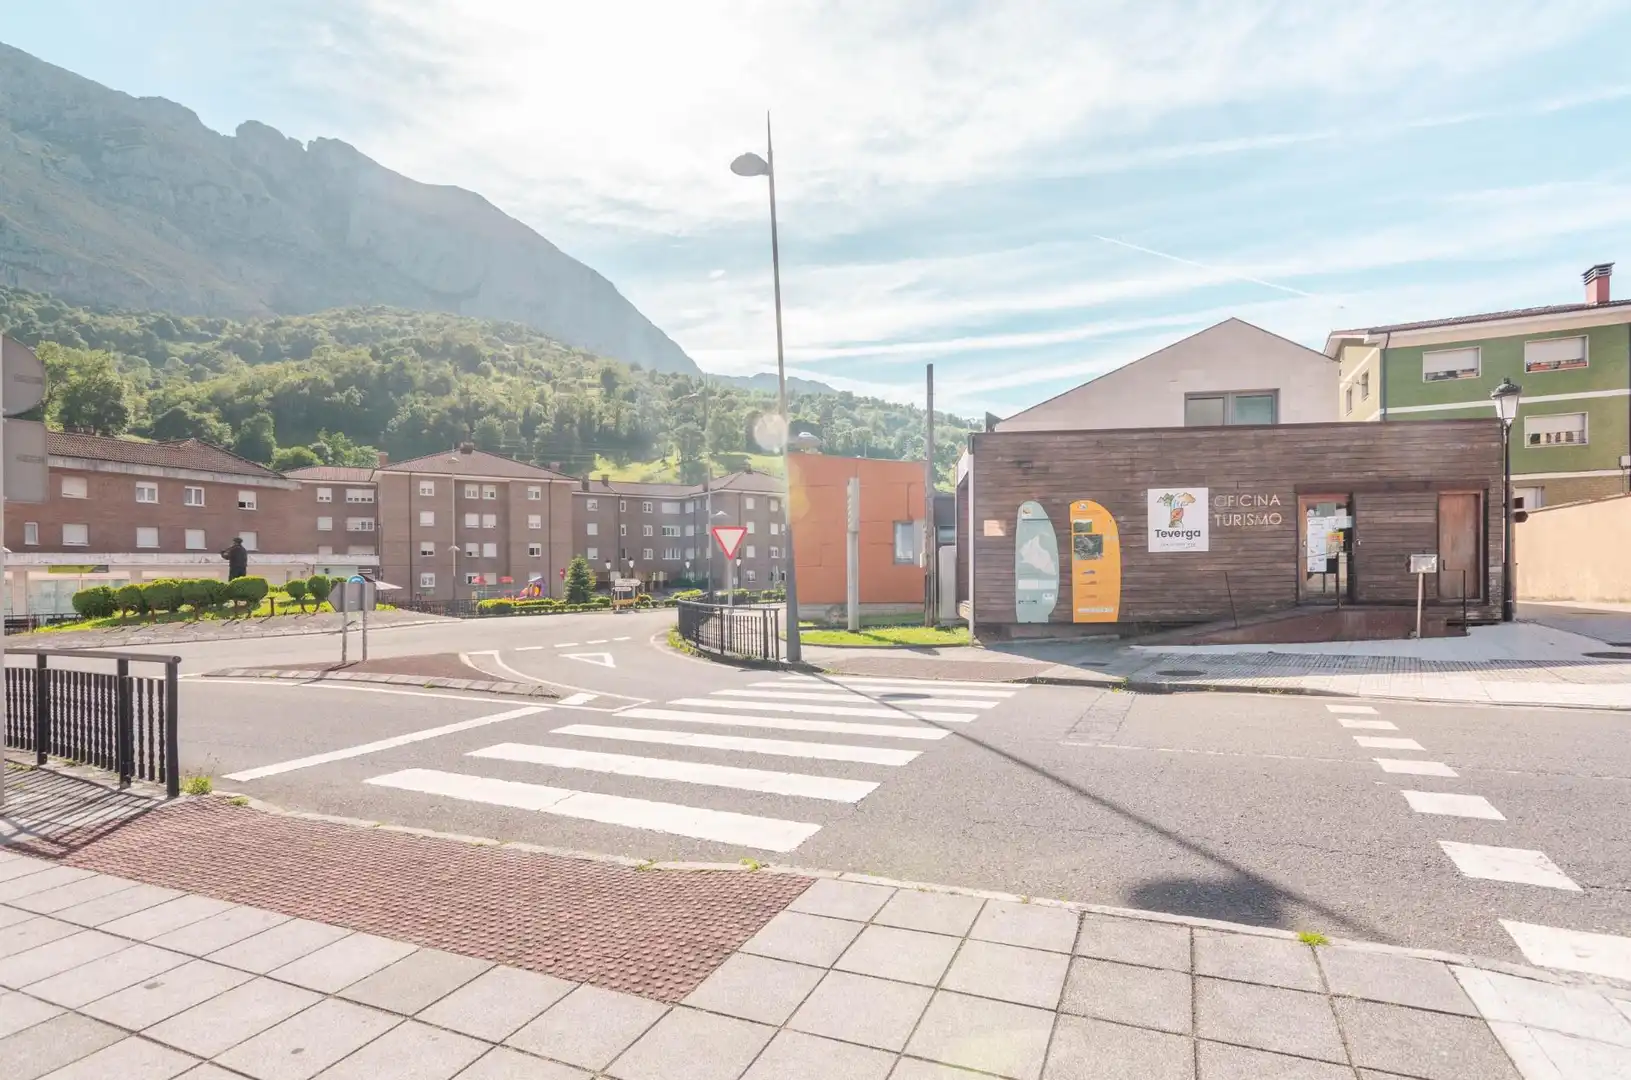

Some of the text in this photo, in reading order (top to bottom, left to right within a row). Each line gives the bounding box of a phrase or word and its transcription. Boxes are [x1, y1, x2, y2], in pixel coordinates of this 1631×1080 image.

[1214, 494, 1281, 507] OFICINA
[1214, 512, 1282, 527] TURISMO
[1154, 529, 1201, 540] Teverga
